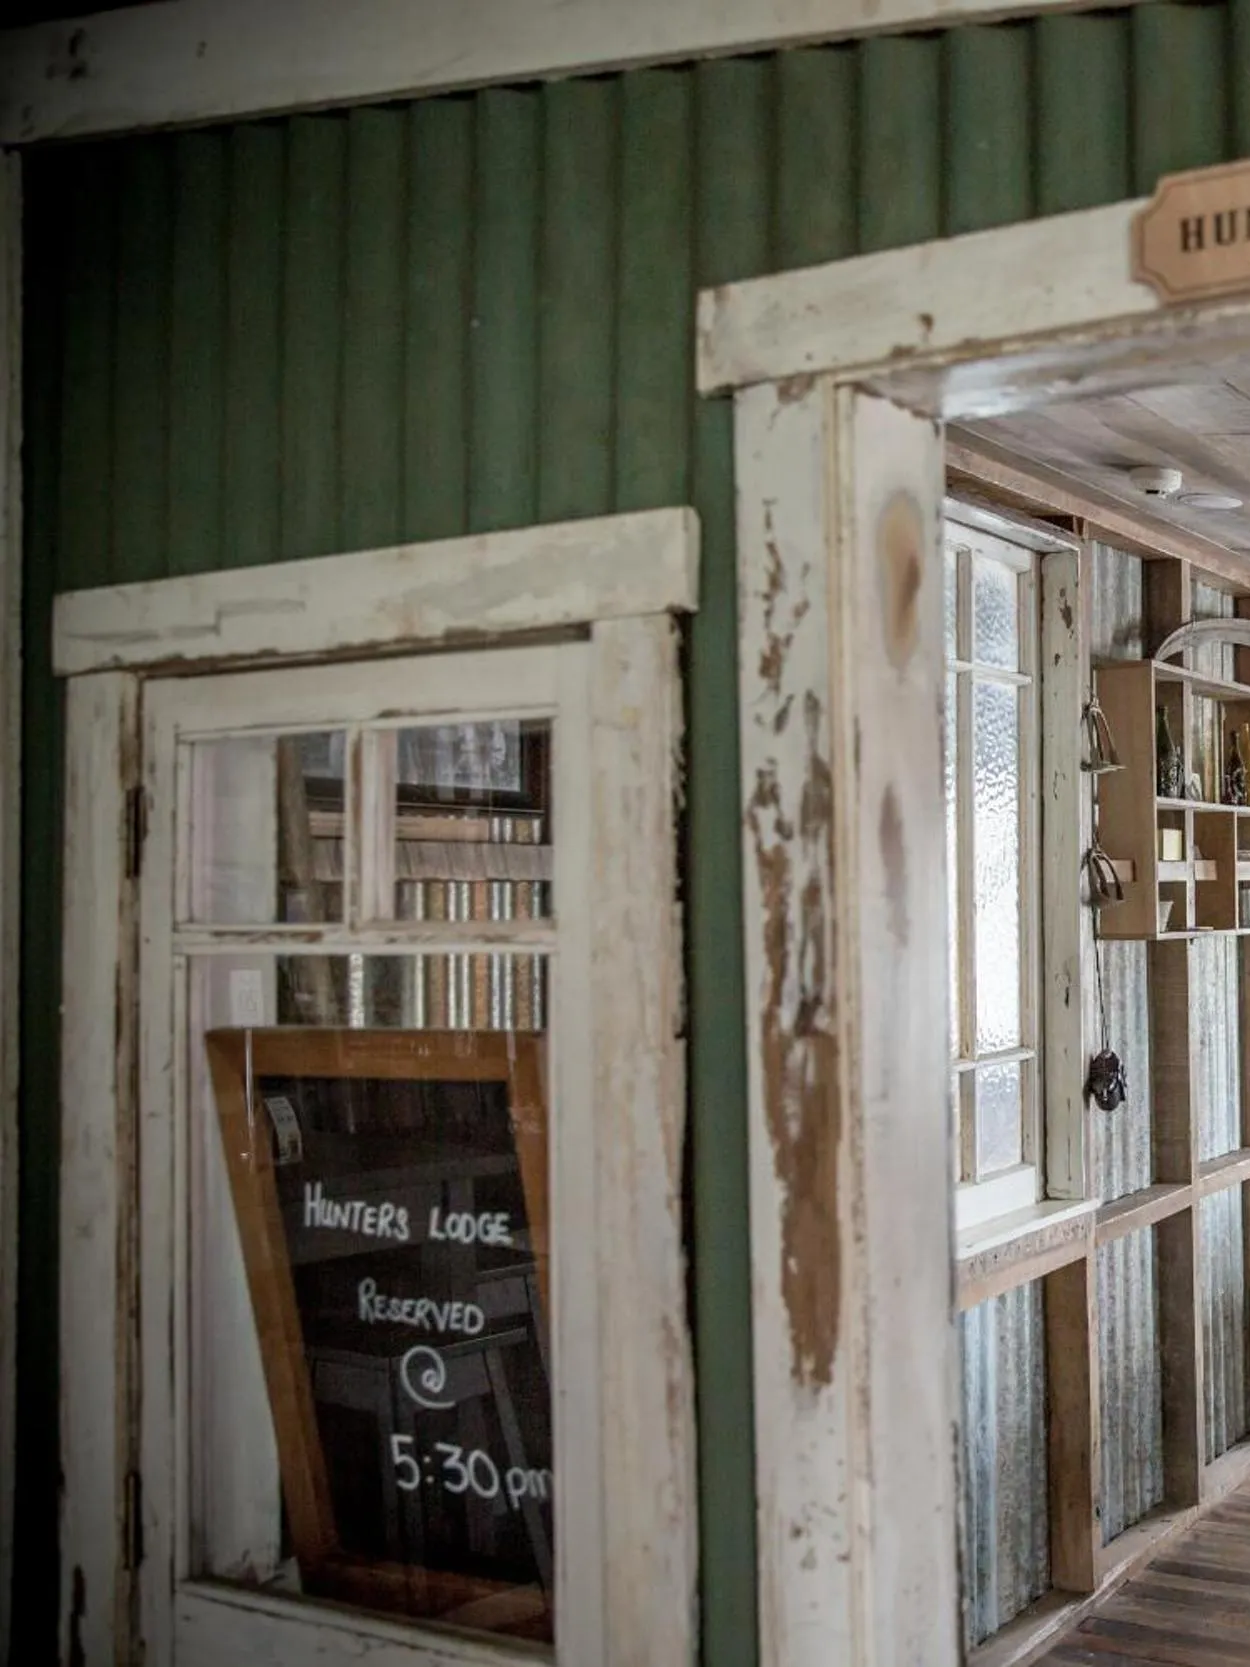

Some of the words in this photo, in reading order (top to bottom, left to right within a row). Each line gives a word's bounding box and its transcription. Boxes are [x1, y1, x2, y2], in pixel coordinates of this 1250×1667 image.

[304, 1182, 409, 1240] HUNTERS
[429, 1207, 513, 1245] LODGE
[358, 1278, 485, 1334] RESERVED
